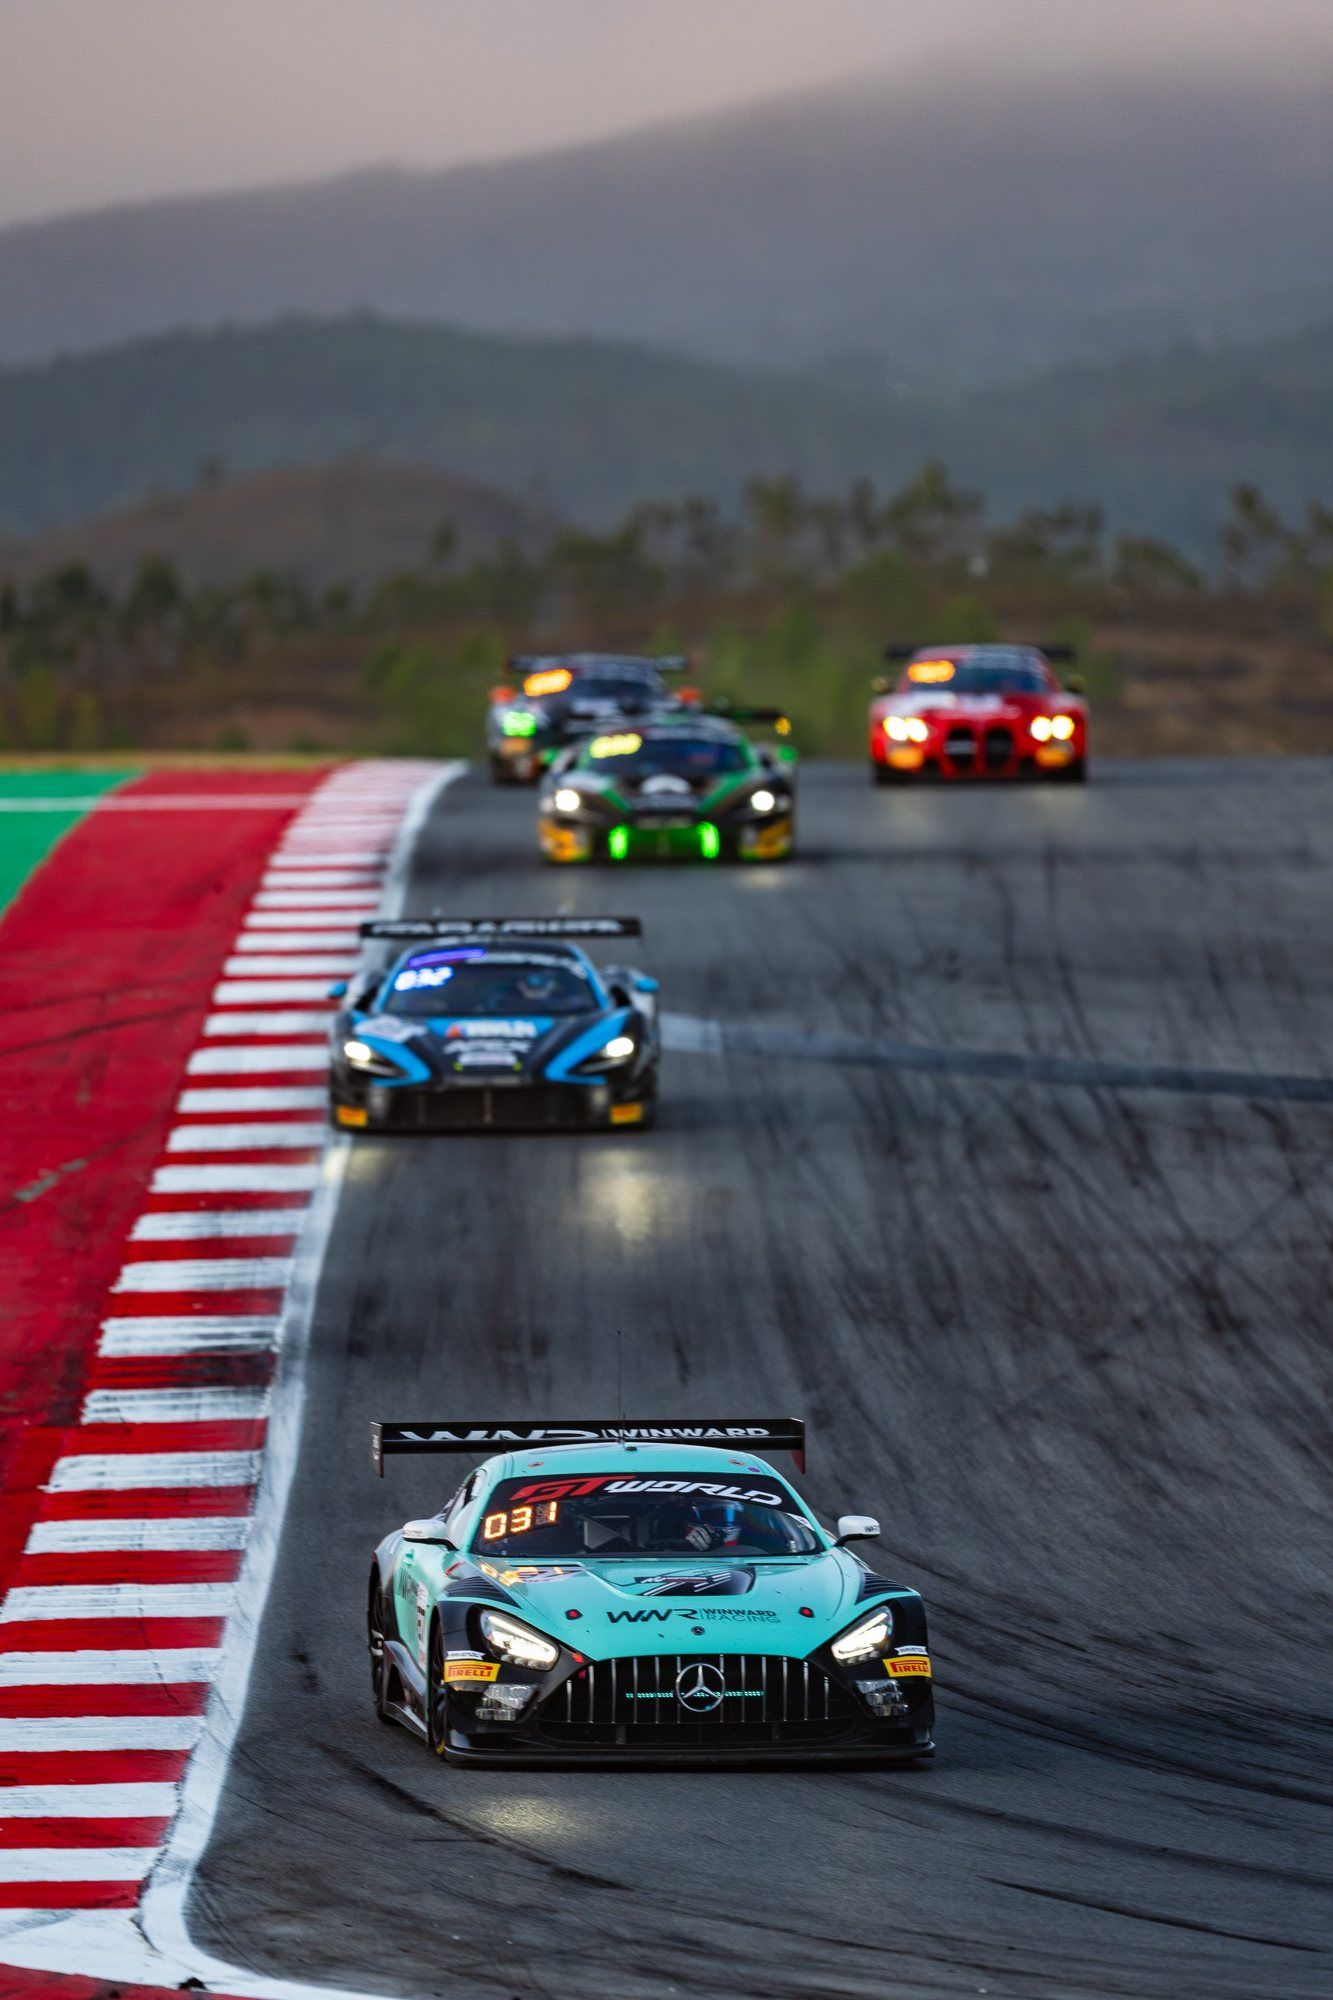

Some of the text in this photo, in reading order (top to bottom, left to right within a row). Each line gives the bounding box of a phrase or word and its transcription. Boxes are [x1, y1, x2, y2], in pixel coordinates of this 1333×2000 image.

[606, 1427, 770, 1438] WINWARD
[484, 1501, 558, 1540] 031
[703, 1608, 777, 1617] WINWARD
[703, 1614, 782, 1624] RACING
[447, 1664, 493, 1678] PIRELLI
